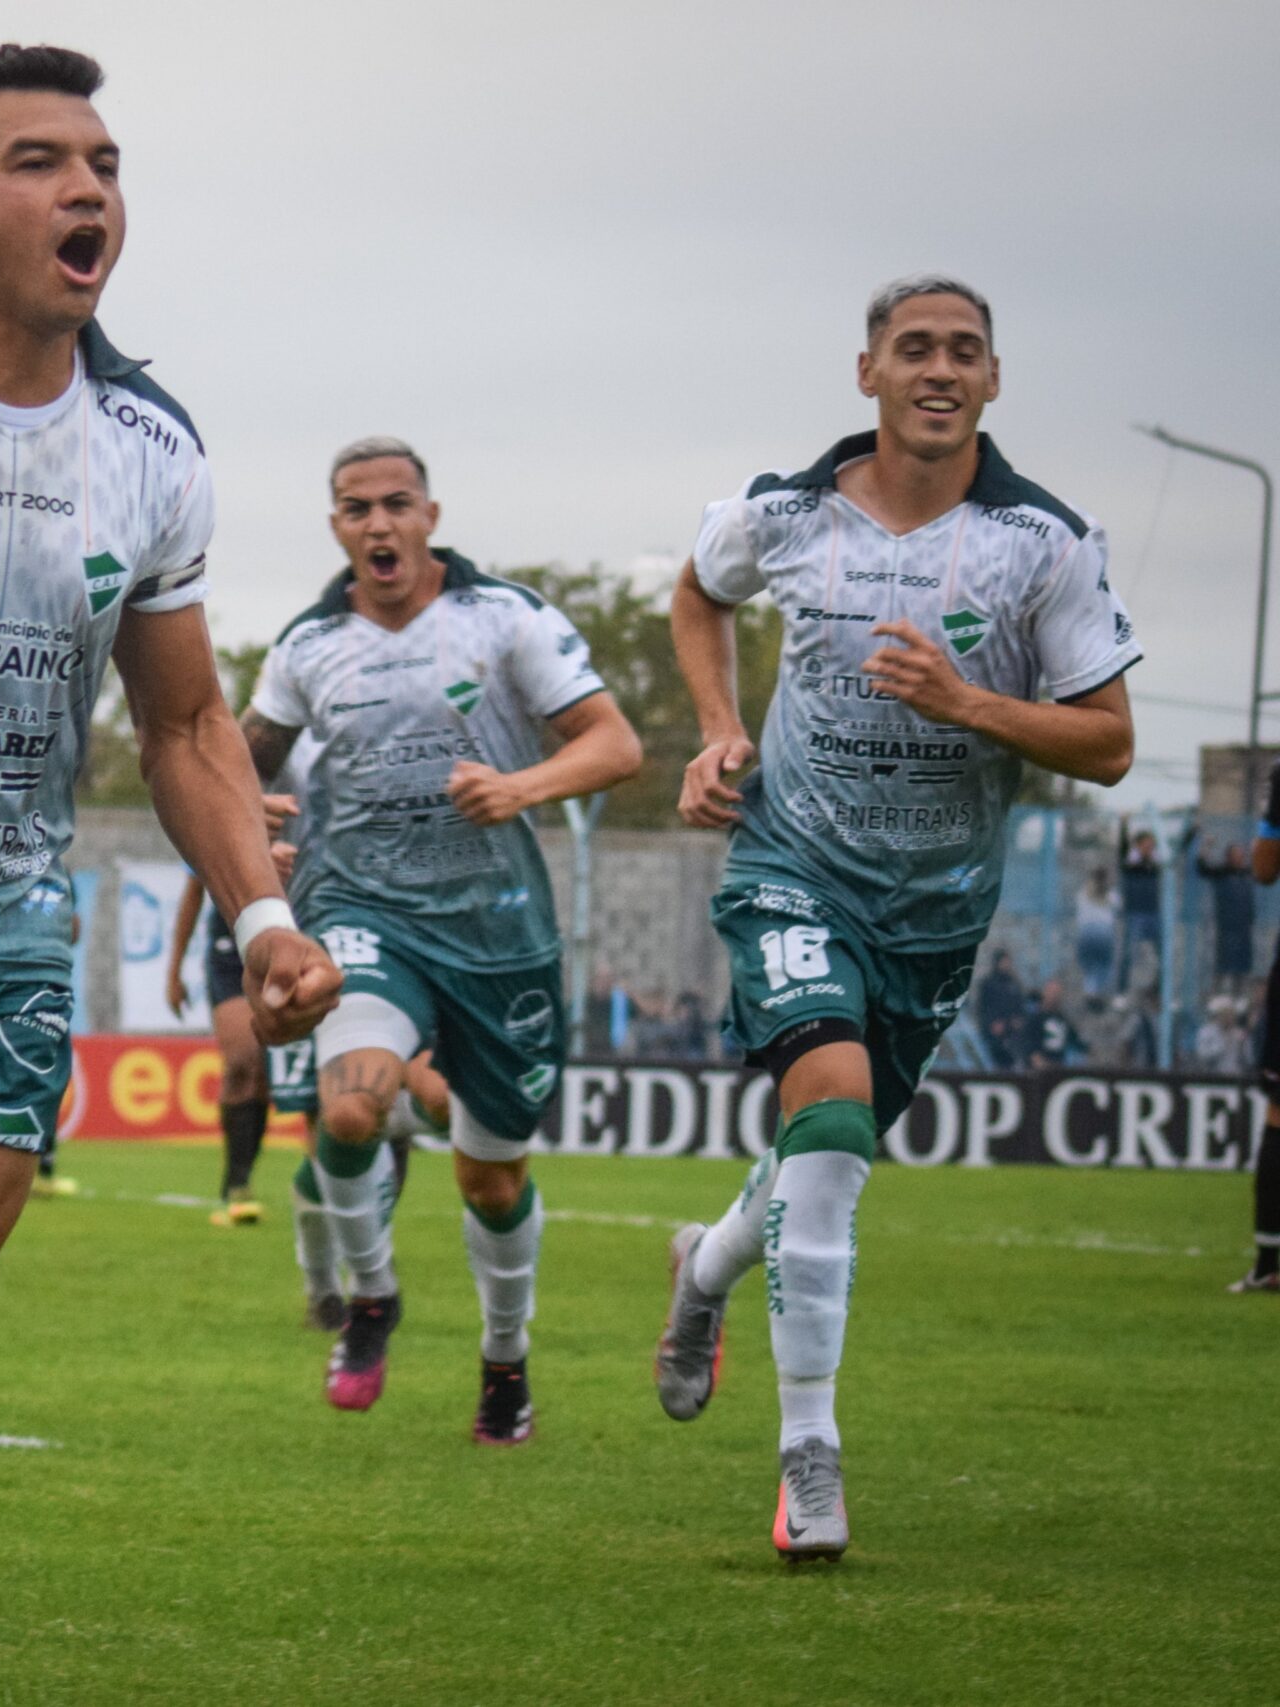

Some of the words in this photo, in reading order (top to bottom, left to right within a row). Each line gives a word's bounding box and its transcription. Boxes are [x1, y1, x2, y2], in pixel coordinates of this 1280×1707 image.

[96, 391, 178, 456] KOSHI
[21, 493, 75, 516] 2000
[764, 497, 819, 516] KIOS
[982, 505, 1050, 539] KIOSHI
[845, 571, 895, 584] SPORT
[900, 574, 941, 589] 2000
[55, 628, 73, 643] de
[841, 720, 929, 735] CARNICERA
[810, 731, 968, 760] PONCHARELO
[835, 801, 971, 832] ENERTRANS
[759, 924, 831, 990] 16
[760, 986, 804, 1010] SPORT
[806, 983, 846, 997] 2000
[268, 1040, 312, 1086] 17
